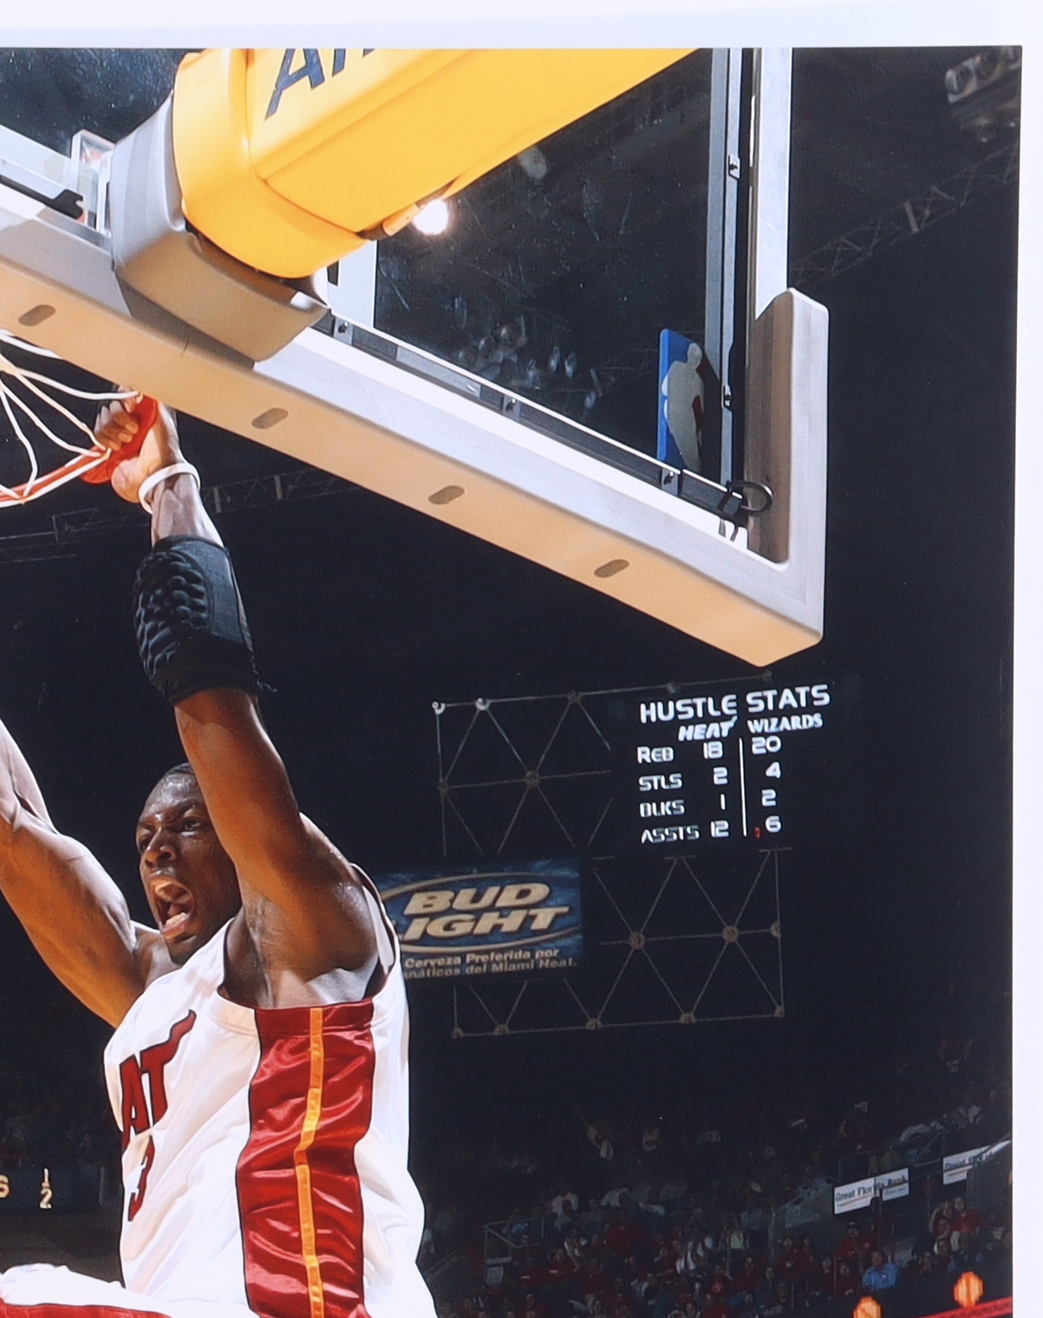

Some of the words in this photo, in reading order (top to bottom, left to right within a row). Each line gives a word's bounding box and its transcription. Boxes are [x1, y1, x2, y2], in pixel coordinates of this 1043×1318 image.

[639, 693, 739, 724] HUSTLE
[745, 684, 831, 713] STATS
[678, 716, 738, 742] HEAT
[747, 713, 824, 735] WIZARDS
[751, 736, 782, 755] 20
[638, 773, 683, 791] STLS
[712, 767, 729, 785] 2
[765, 761, 782, 779] 4
[639, 799, 685, 818] BLKS
[761, 788, 777, 807] 2
[640, 825, 700, 844] ASSTS
[710, 820, 730, 838] 12
[764, 815, 782, 833] 6
[403, 883, 550, 915] BUD
[404, 956, 462, 969] Cerveza
[465, 950, 531, 964] Preferida
[535, 949, 560, 963] por
[465, 961, 487, 975] del
[491, 958, 534, 973] Miami
[39, 1188, 52, 1210] 2
